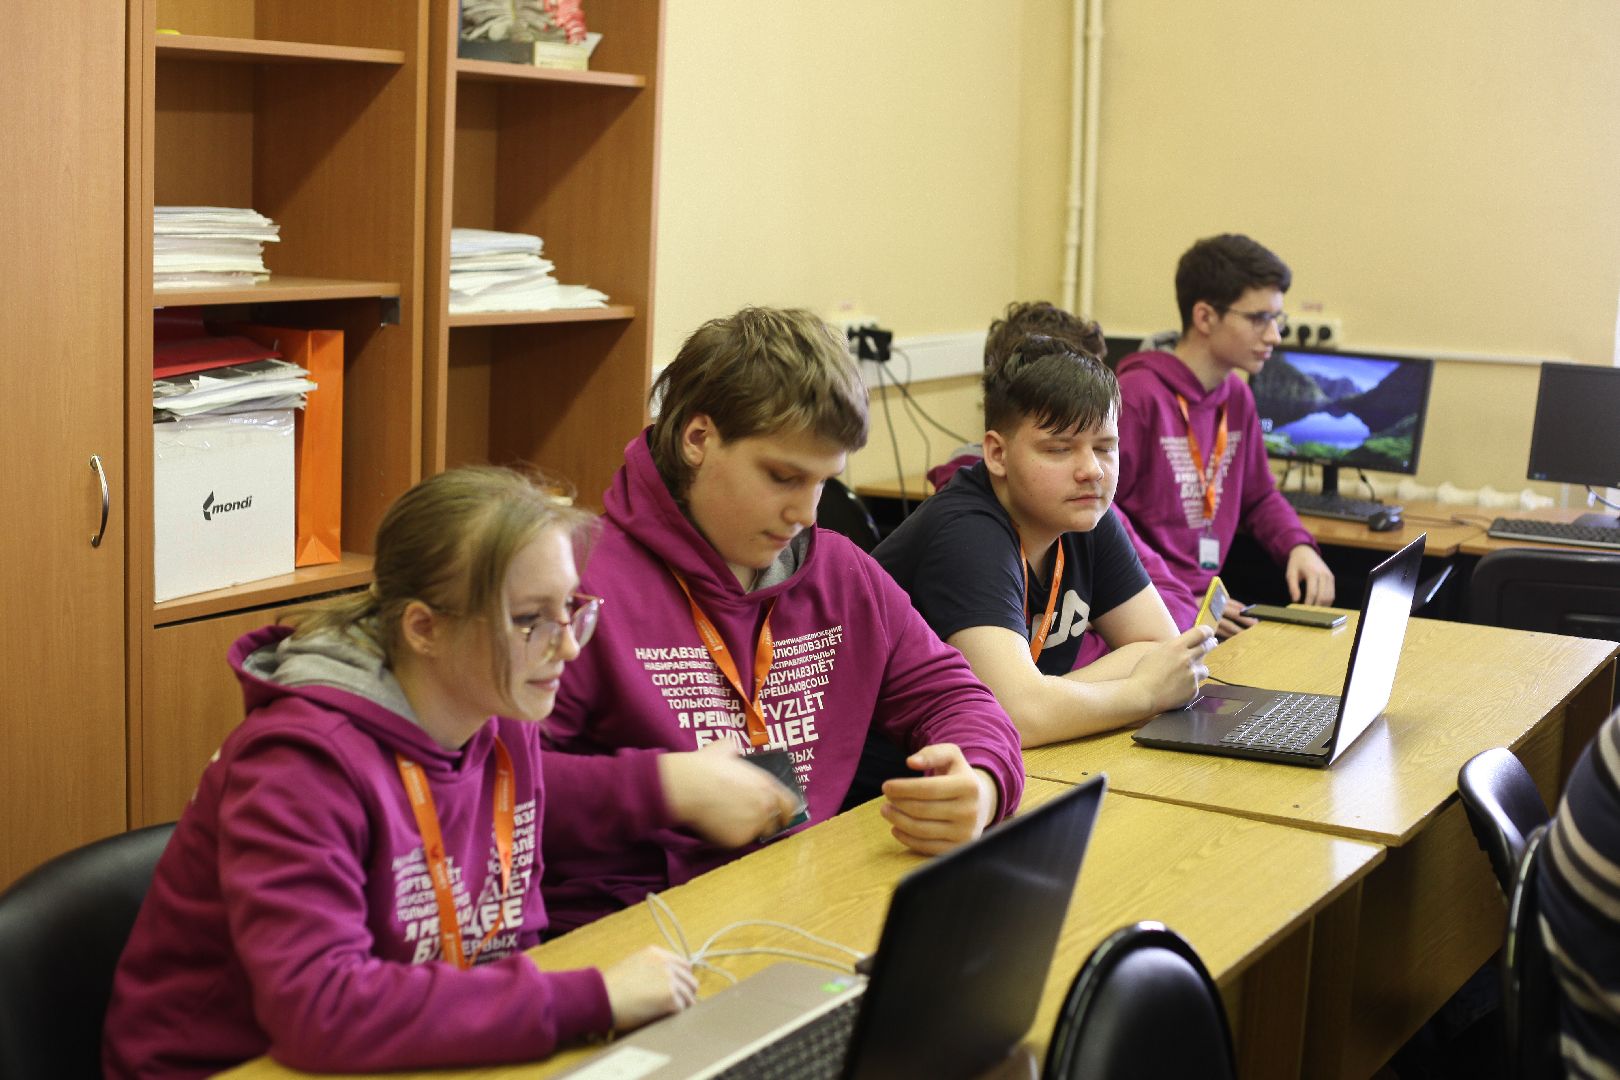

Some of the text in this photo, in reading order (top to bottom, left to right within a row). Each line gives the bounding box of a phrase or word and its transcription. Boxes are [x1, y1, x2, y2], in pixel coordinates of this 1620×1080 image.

[212, 495, 253, 514] mondi
[635, 646, 709, 660] НАУКАВЗЛЁ
[677, 712, 691, 729] Я
